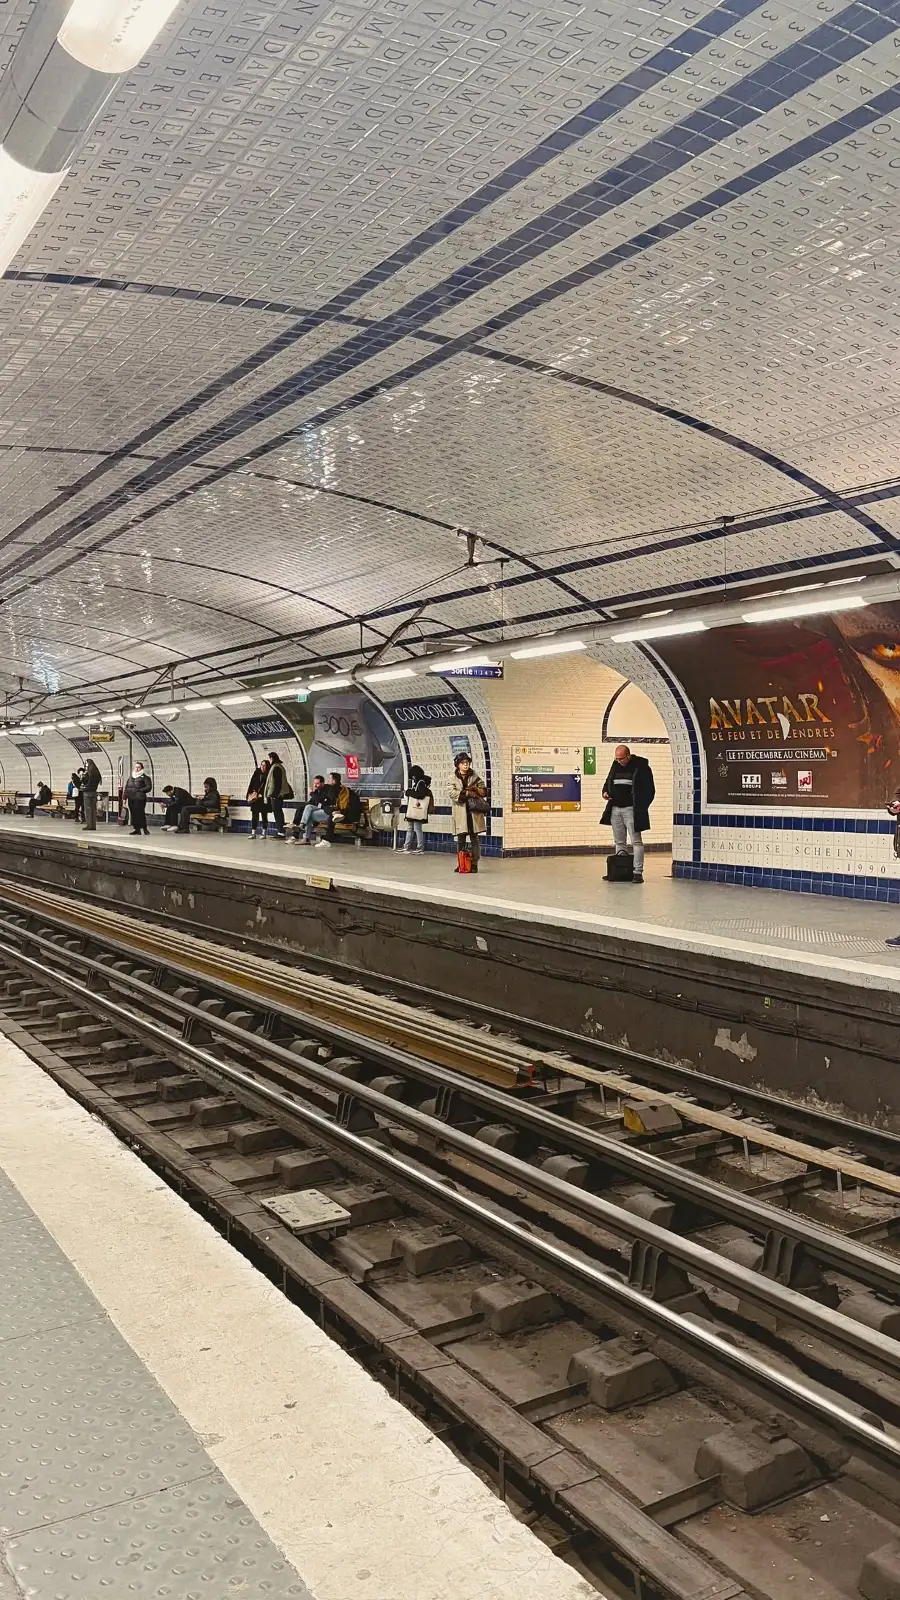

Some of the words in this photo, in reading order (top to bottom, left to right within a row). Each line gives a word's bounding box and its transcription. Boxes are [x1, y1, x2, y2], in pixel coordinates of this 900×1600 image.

[395, 702, 465, 722] CONCORDE
[709, 693, 832, 729] AVATAR
[242, 720, 288, 735] CONCORDE
[711, 732, 724, 741] DE
[728, 731, 745, 741] FEU
[750, 730, 762, 740] ET
[767, 730, 781, 739] DE
[746, 750, 782, 759] DÉCEMBRE
[795, 749, 825, 759] CINÉMA
[703, 840, 780, 853] FRANCOISE
[795, 845, 853, 857] SCHEIN
[847, 863, 886, 874] 1990
